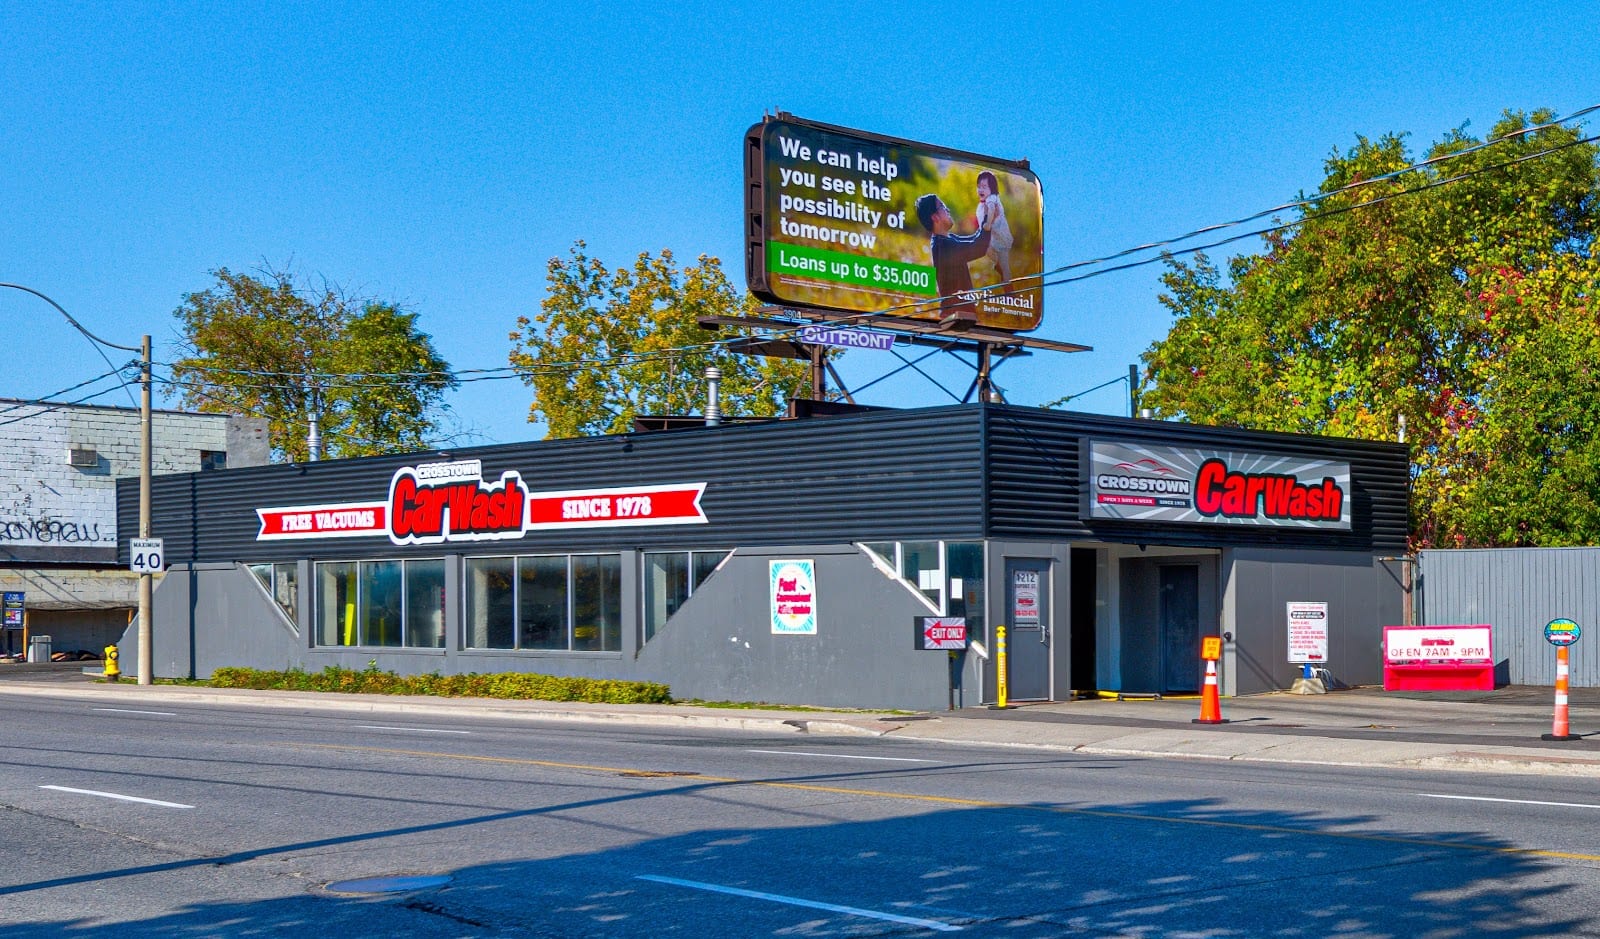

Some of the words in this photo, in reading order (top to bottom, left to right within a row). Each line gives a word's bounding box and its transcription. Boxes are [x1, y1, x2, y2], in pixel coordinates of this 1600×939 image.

[780, 136, 811, 161] We
[817, 149, 851, 169] can
[857, 151, 898, 181] help
[780, 167, 816, 188] you
[821, 176, 856, 195] see
[861, 180, 892, 202] the
[780, 194, 882, 229] possibility
[886, 211, 906, 230] of
[780, 216, 877, 250] tomorrow
[780, 250, 827, 272] Loans
[831, 261, 850, 279] up
[853, 262, 868, 279] to
[873, 263, 929, 288] $35,000
[983, 304, 1001, 313] Better
[803, 327, 891, 349] OUTFRONT
[418, 462, 479, 479] CROSSTOWN
[1098, 475, 1190, 494] CROSSTOWN
[562, 498, 611, 519] SINCE
[616, 495, 652, 516] 1978
[281, 513, 313, 531] FREE
[315, 510, 375, 529] VACUUMS
[133, 552, 160, 568] 40
[1016, 573, 1035, 583] 1212
[931, 627, 946, 639] EXIT
[946, 627, 964, 639] ONLY
[1425, 648, 1449, 657] 7AM
[1460, 647, 1484, 657] 9PM
